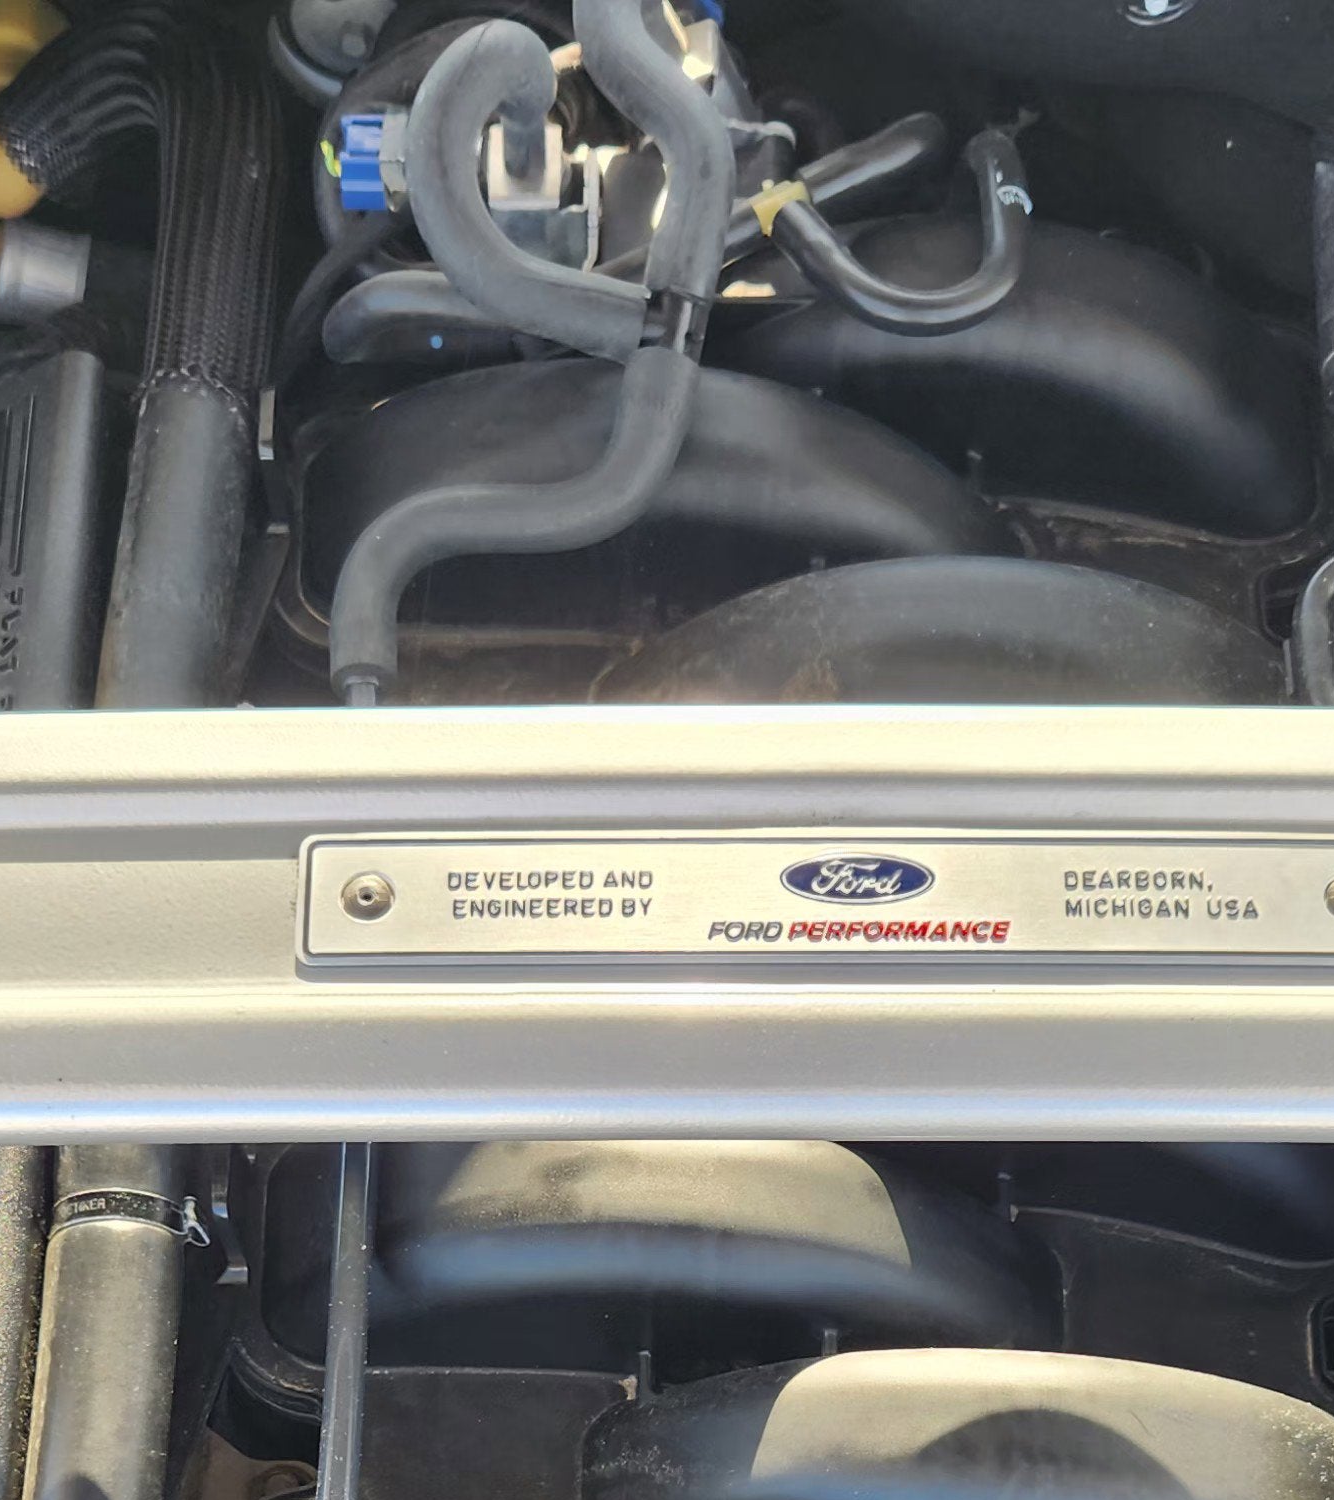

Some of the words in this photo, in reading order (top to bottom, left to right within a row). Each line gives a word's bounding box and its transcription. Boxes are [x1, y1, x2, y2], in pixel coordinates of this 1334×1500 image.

[448, 871, 594, 891] DEVELOPED
[603, 870, 653, 889] AND
[811, 858, 902, 895] Ford
[1064, 870, 1213, 892] DEARBORN,
[453, 898, 613, 919] ENGINEERED
[621, 897, 653, 917] BY
[1065, 898, 1190, 919] MICHIGAN
[1207, 898, 1259, 920] USA
[708, 920, 783, 942] FORD
[788, 920, 1011, 944] PERFORMANCE
